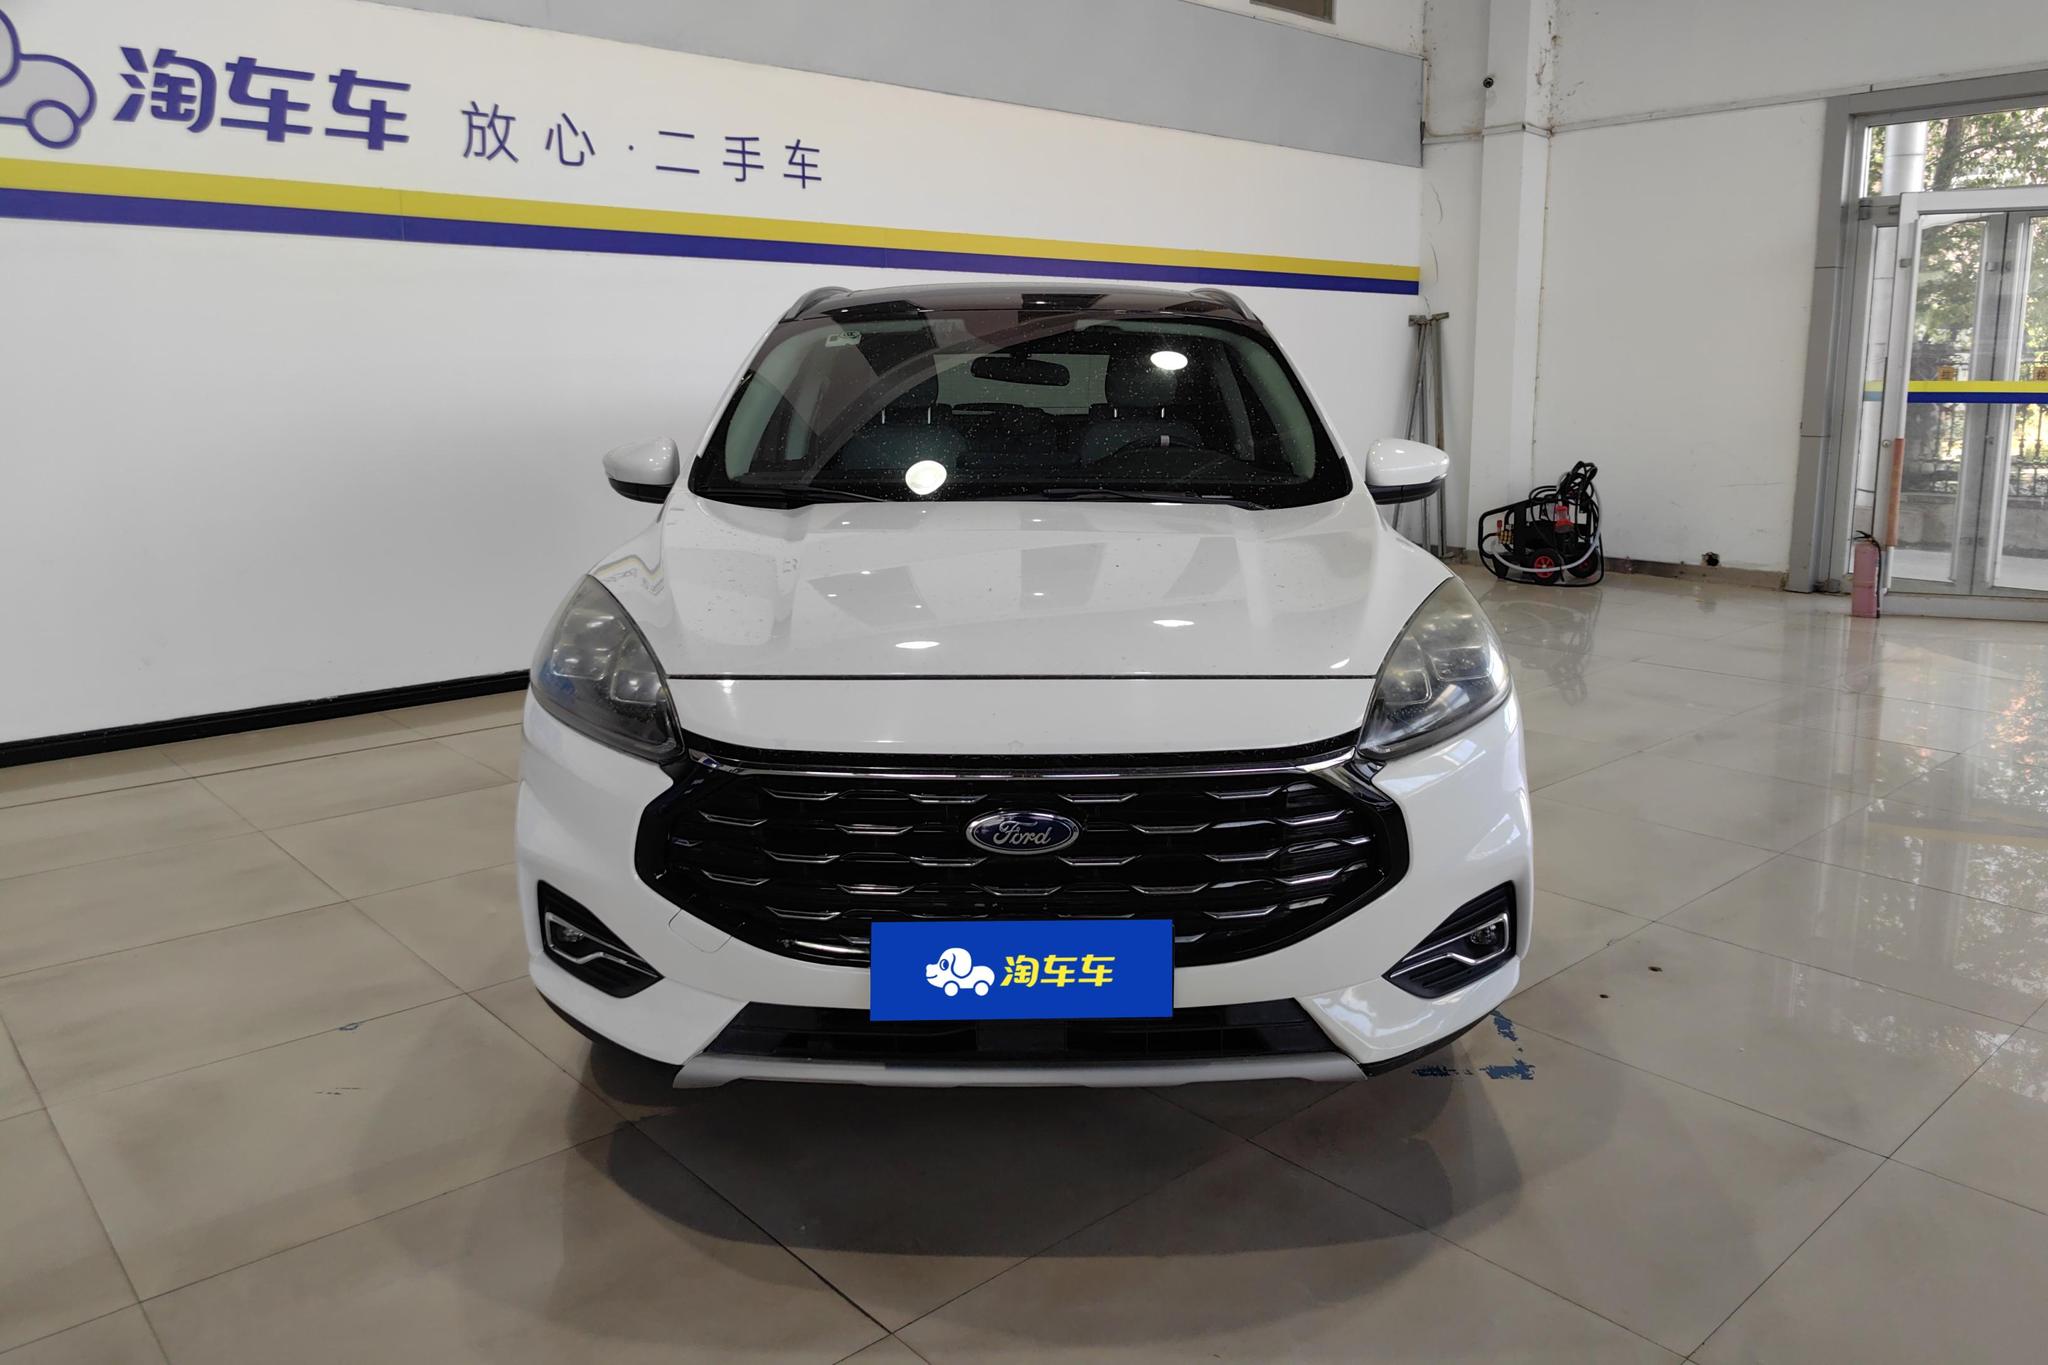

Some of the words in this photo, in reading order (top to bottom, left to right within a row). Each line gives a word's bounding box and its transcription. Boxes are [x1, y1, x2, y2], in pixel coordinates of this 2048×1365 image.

[112, 46, 412, 151] 淘车车
[993, 819, 1053, 845] Ford
